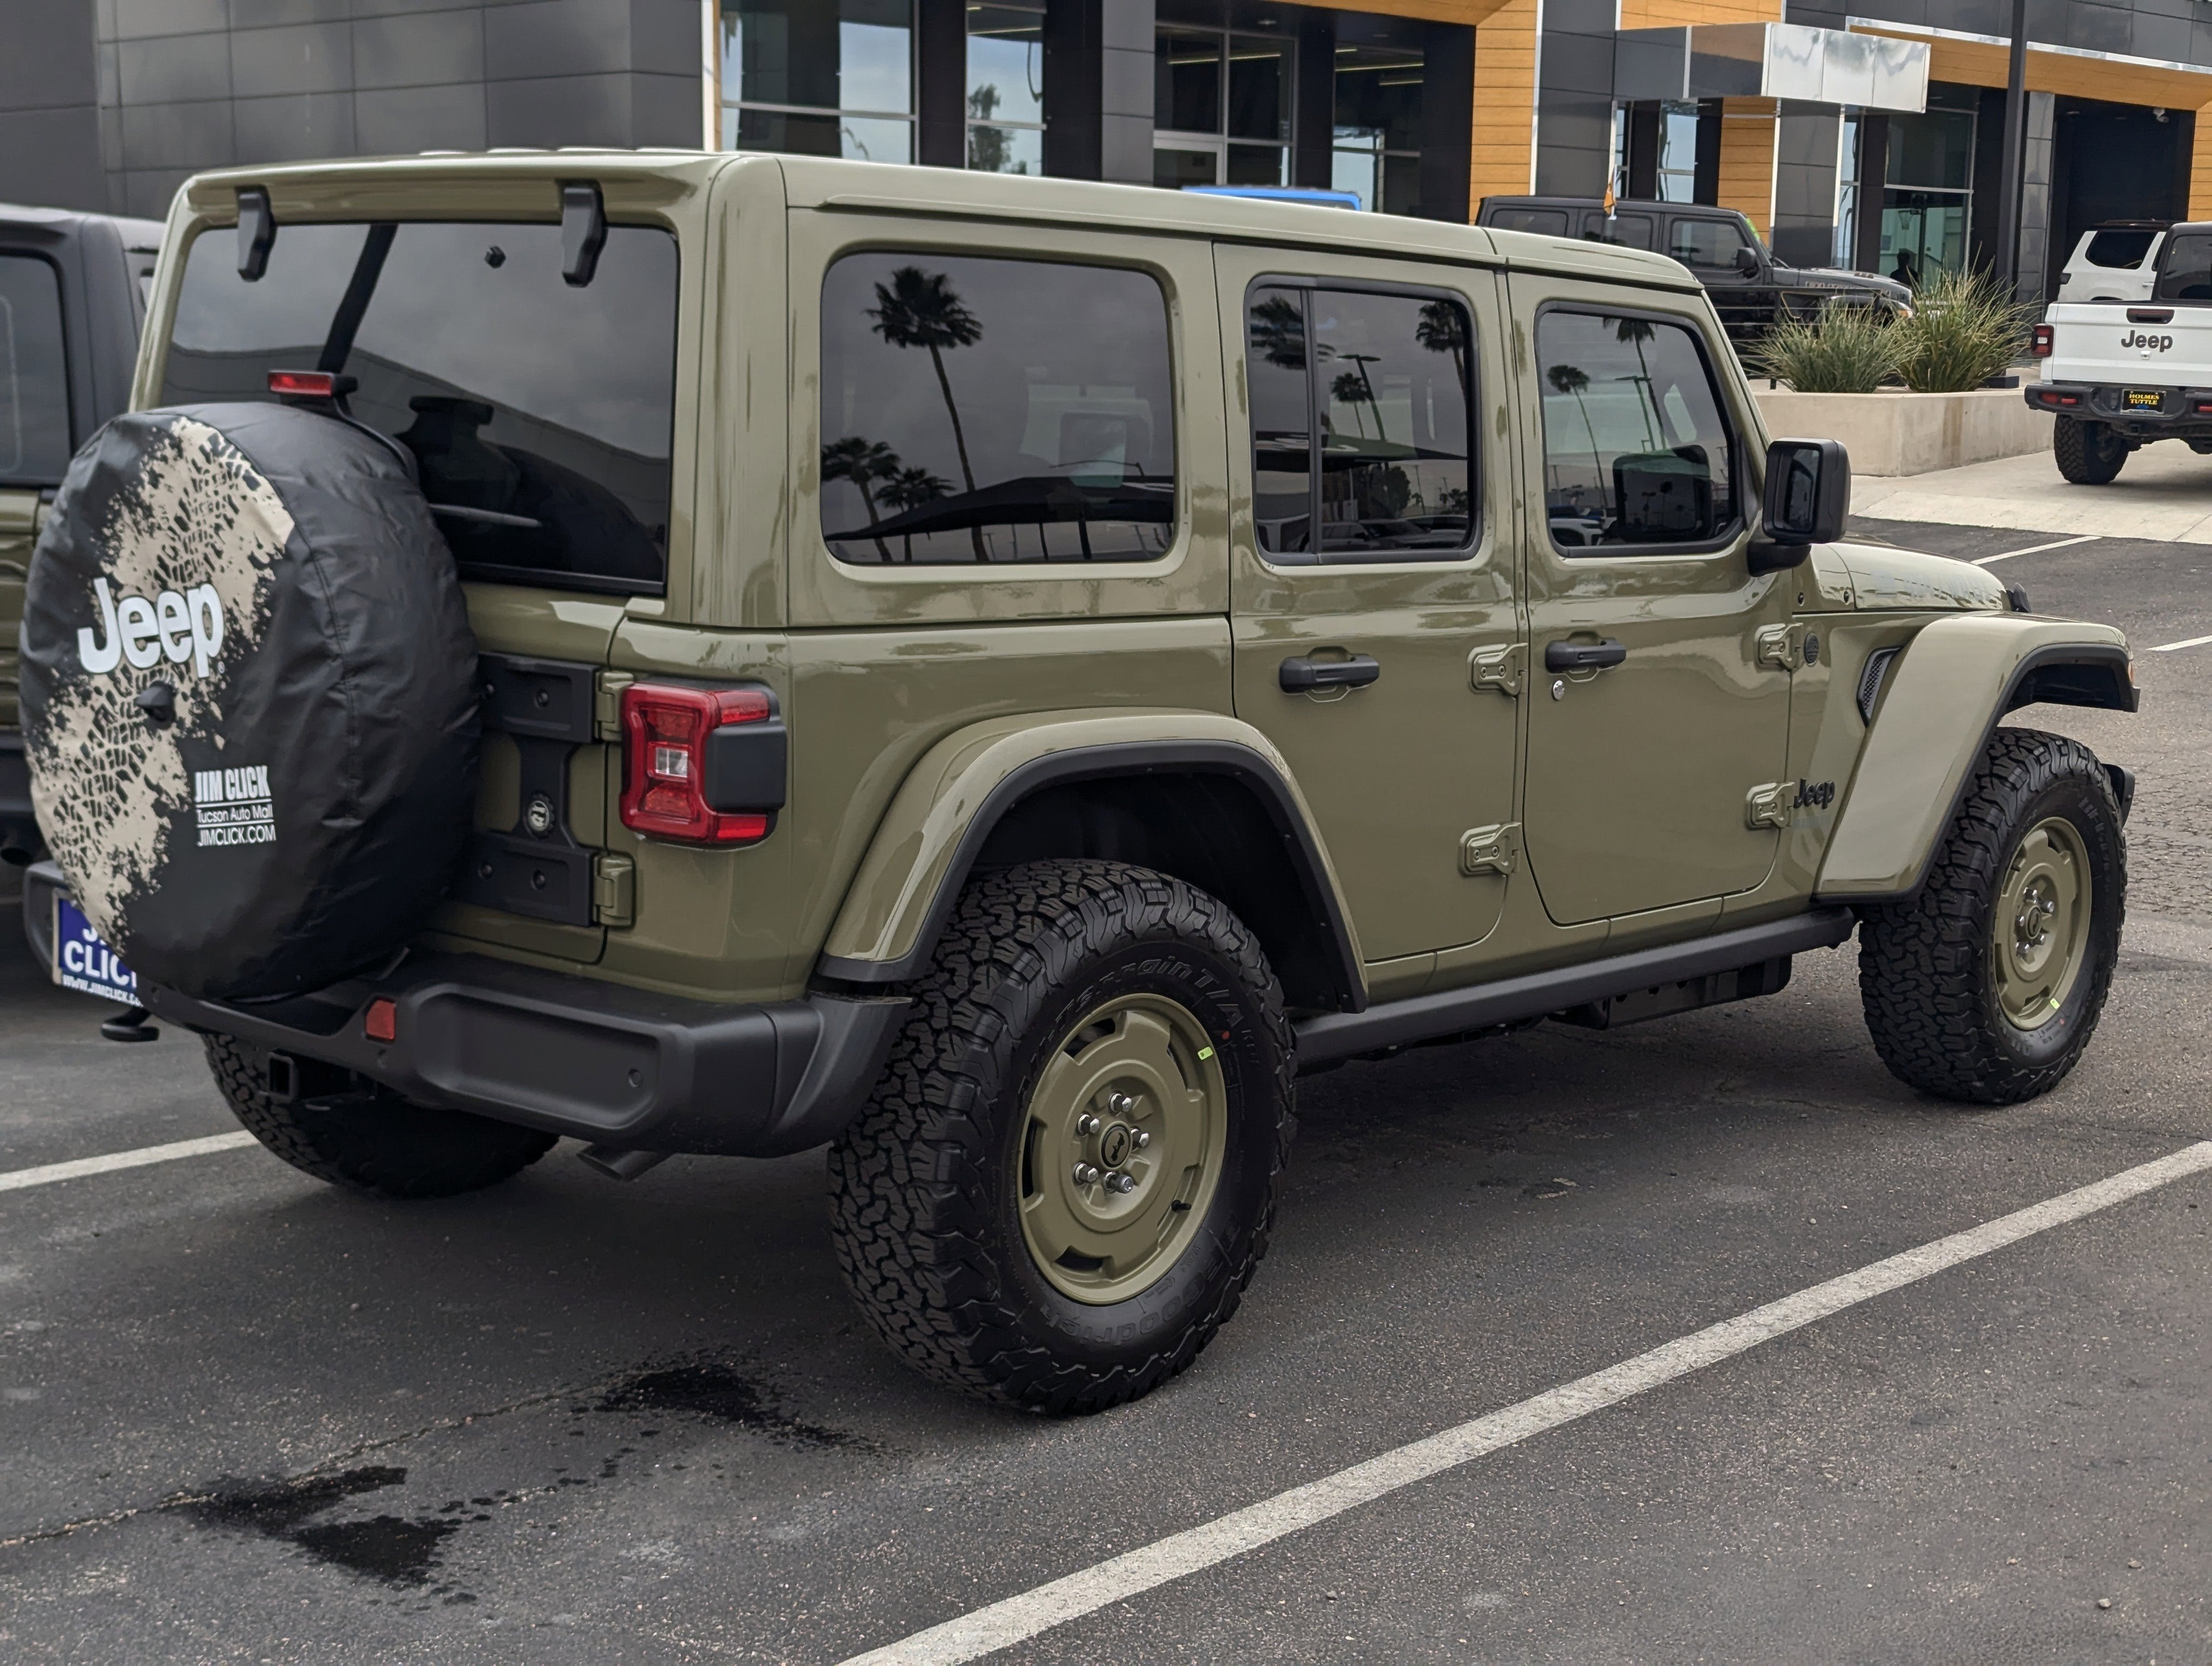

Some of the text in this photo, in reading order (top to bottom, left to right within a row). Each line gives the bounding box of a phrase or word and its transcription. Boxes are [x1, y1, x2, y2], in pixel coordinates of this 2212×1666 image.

[2121, 330, 2173, 353] Jeep
[78, 577, 223, 677] Jeep
[195, 765, 271, 803] JIM CLICK
[1793, 778, 1835, 809] Jeep
[196, 803, 273, 823] Tucson Auto Mall
[197, 824, 276, 847] JIMCLICK.COM
